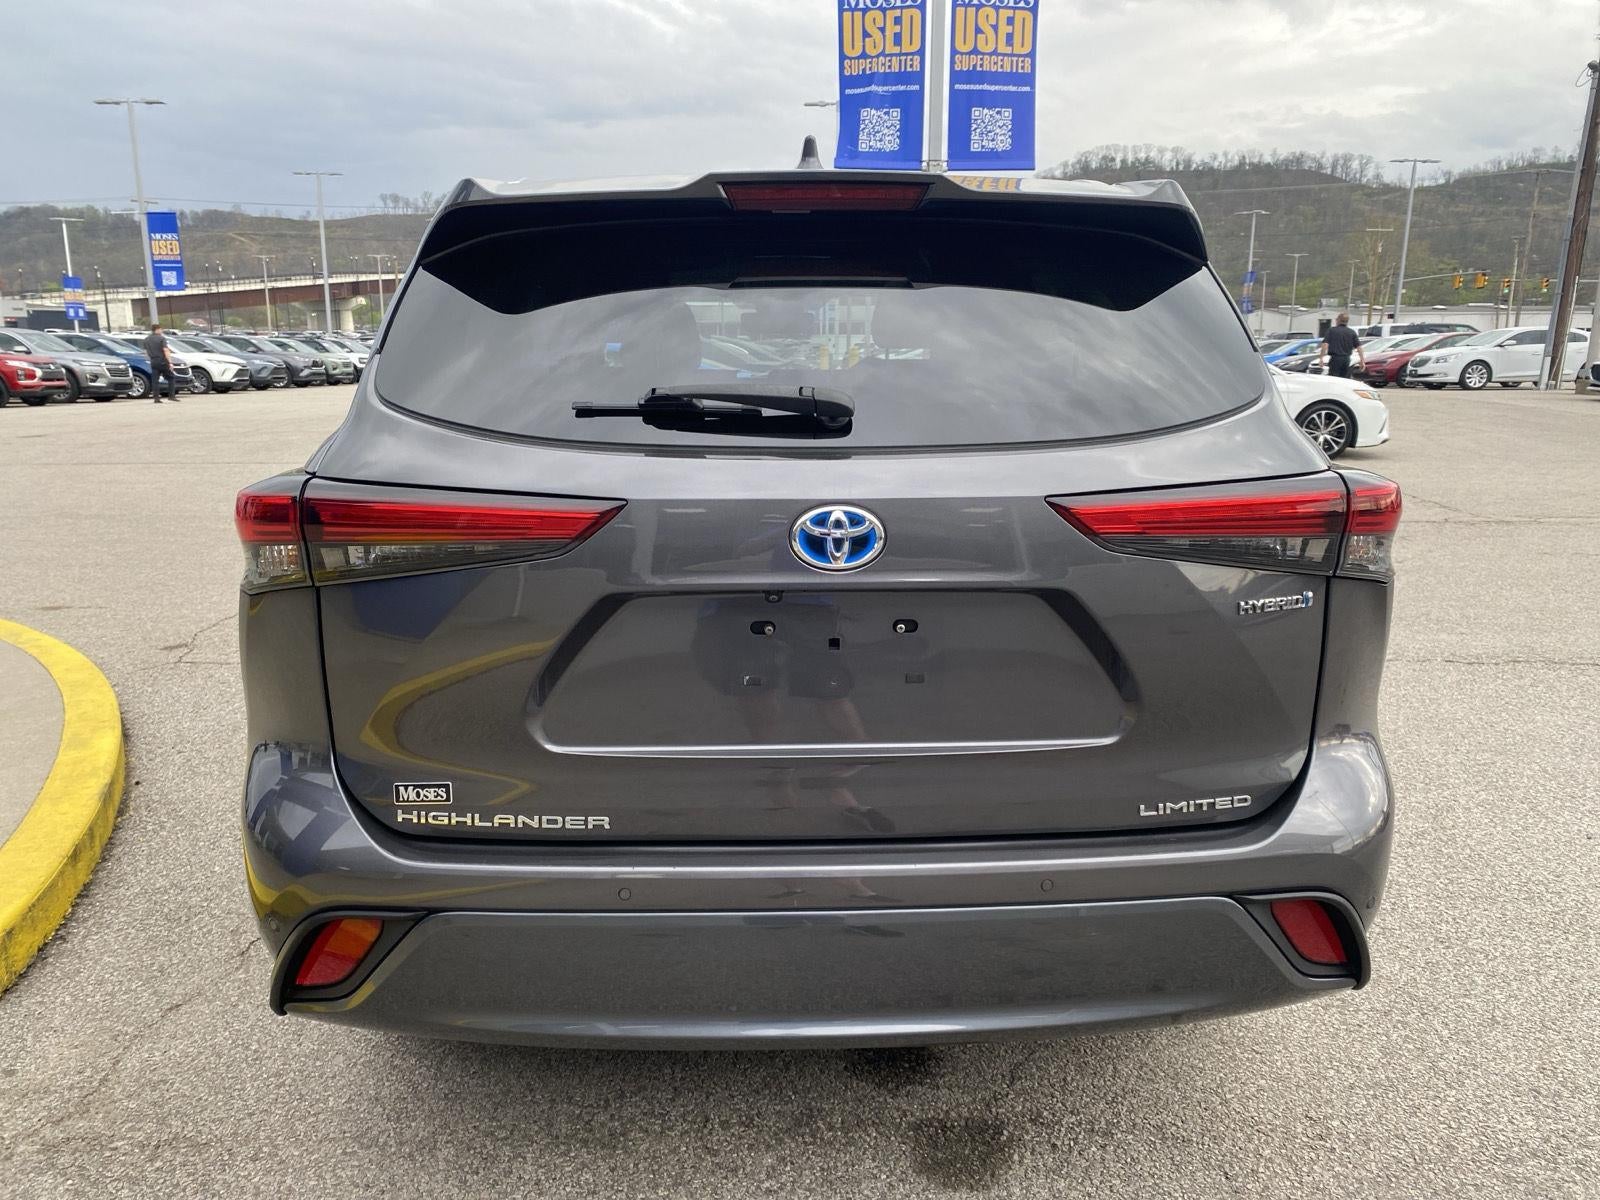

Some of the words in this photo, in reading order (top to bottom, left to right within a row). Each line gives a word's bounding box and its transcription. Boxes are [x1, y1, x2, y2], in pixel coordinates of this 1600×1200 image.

[843, 8, 922, 57] USED
[954, 6, 1033, 54] USED
[844, 55, 920, 75] SUPERCENTER
[954, 54, 1031, 73] SUPERCENTER
[151, 240, 180, 255] USED
[1238, 595, 1304, 615] HYBRID
[1139, 794, 1252, 817] LIMITED
[397, 809, 611, 829] HIGHLANDER
